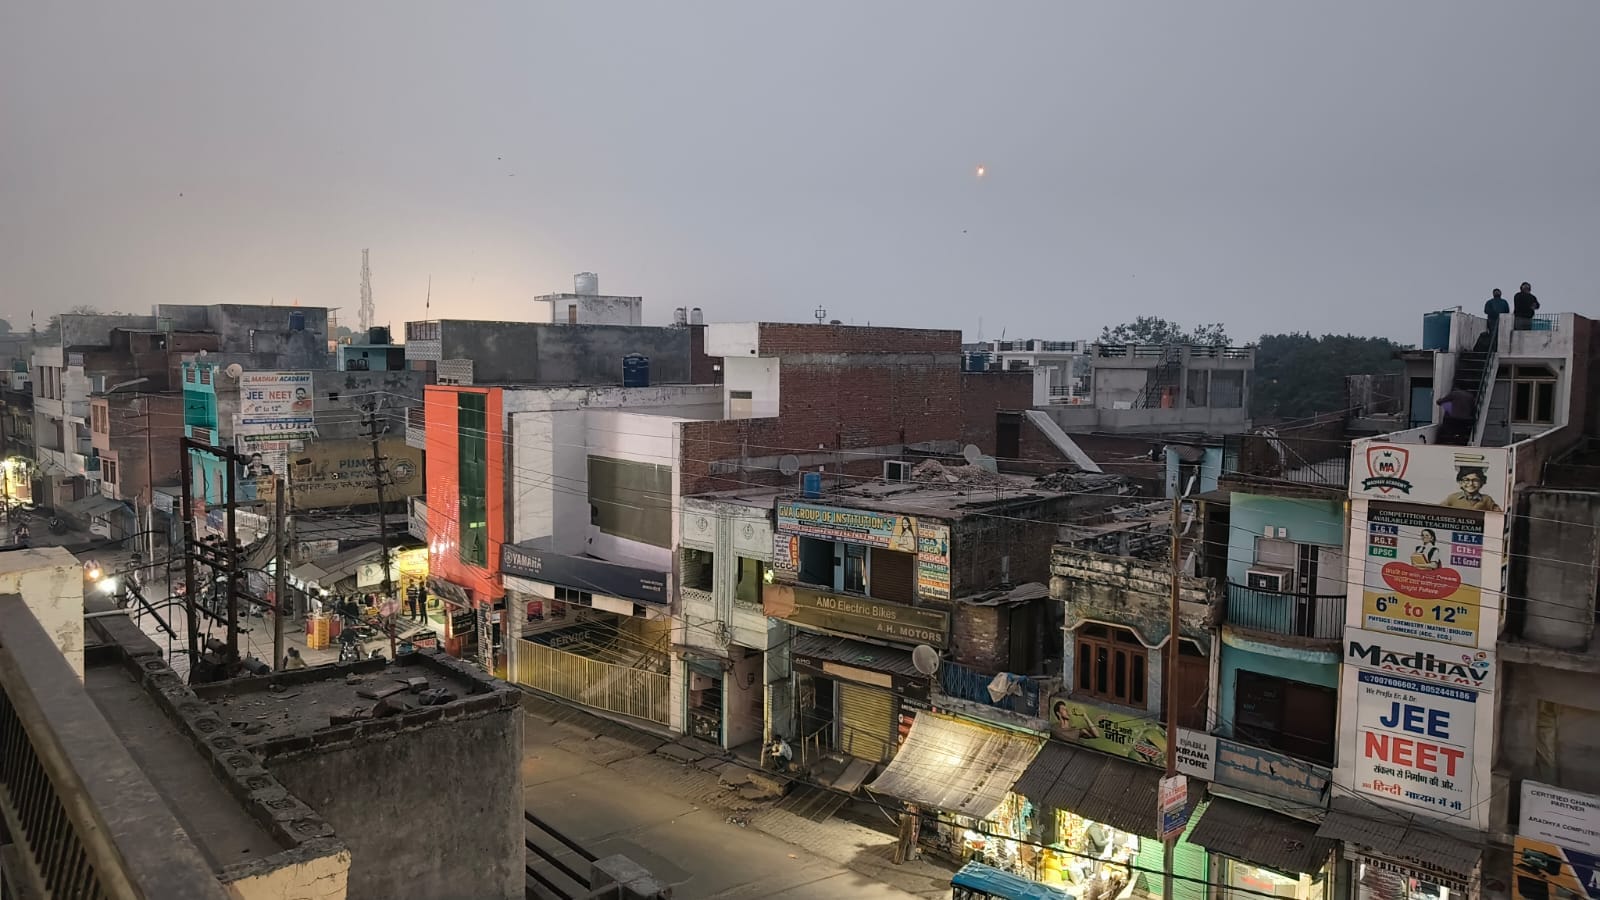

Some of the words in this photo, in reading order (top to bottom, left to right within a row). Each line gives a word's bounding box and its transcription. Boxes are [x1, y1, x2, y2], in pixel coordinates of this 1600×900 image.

[246, 391, 264, 400] JEE
[269, 391, 292, 399] NEET
[795, 508, 820, 521] GROUP
[823, 511, 832, 522] OF
[1373, 515, 1410, 525] AVAILABLE
[1410, 518, 1424, 526] FOR
[1425, 520, 1460, 530] TEACHING
[1461, 523, 1482, 531] EXAM
[1379, 511, 1426, 520] COMPETITION
[1427, 514, 1456, 523] CLASSES
[1456, 516, 1476, 524] ALSO
[512, 552, 542, 570] YAMAHA
[774, 561, 792, 569] CCC
[816, 597, 836, 609] AMO
[838, 600, 870, 615] Electric
[872, 606, 897, 620] Bikes
[1376, 596, 1398, 613] 6th
[1404, 602, 1424, 618] to
[1432, 605, 1468, 623] 12th
[876, 624, 896, 634] A.H.
[900, 627, 942, 641] MOTORS
[1368, 616, 1391, 624] PHYSICS
[1393, 619, 1424, 629] CHEMISTRY
[1426, 624, 1446, 632] MATHS
[1448, 628, 1473, 637] BIOLOGY
[1386, 625, 1418, 635] COMMERCE
[550, 631, 591, 647] SERVICE
[1381, 664, 1483, 687] ACADEMY
[1366, 687, 1374, 695] We
[1098, 718, 1113, 730] डर
[1380, 701, 1450, 739] JEE
[1104, 729, 1126, 745] जीत
[1175, 745, 1209, 761] KIRANA
[1365, 731, 1464, 777] NEET
[1177, 755, 1208, 769] STORE
[1373, 763, 1395, 777] संकल्प
[1397, 766, 1403, 779] से
[1405, 769, 1427, 784] निर्माण
[1429, 776, 1439, 787] की
[1373, 779, 1402, 796] हिन्दी
[1405, 790, 1436, 806] माध्यम
[1449, 800, 1462, 810] भी
[1531, 790, 1569, 803] CERTIFIED
[1551, 800, 1585, 812] PARTNER
[1528, 816, 1560, 827] ARADHYA
[1364, 857, 1406, 875] MOBILE
